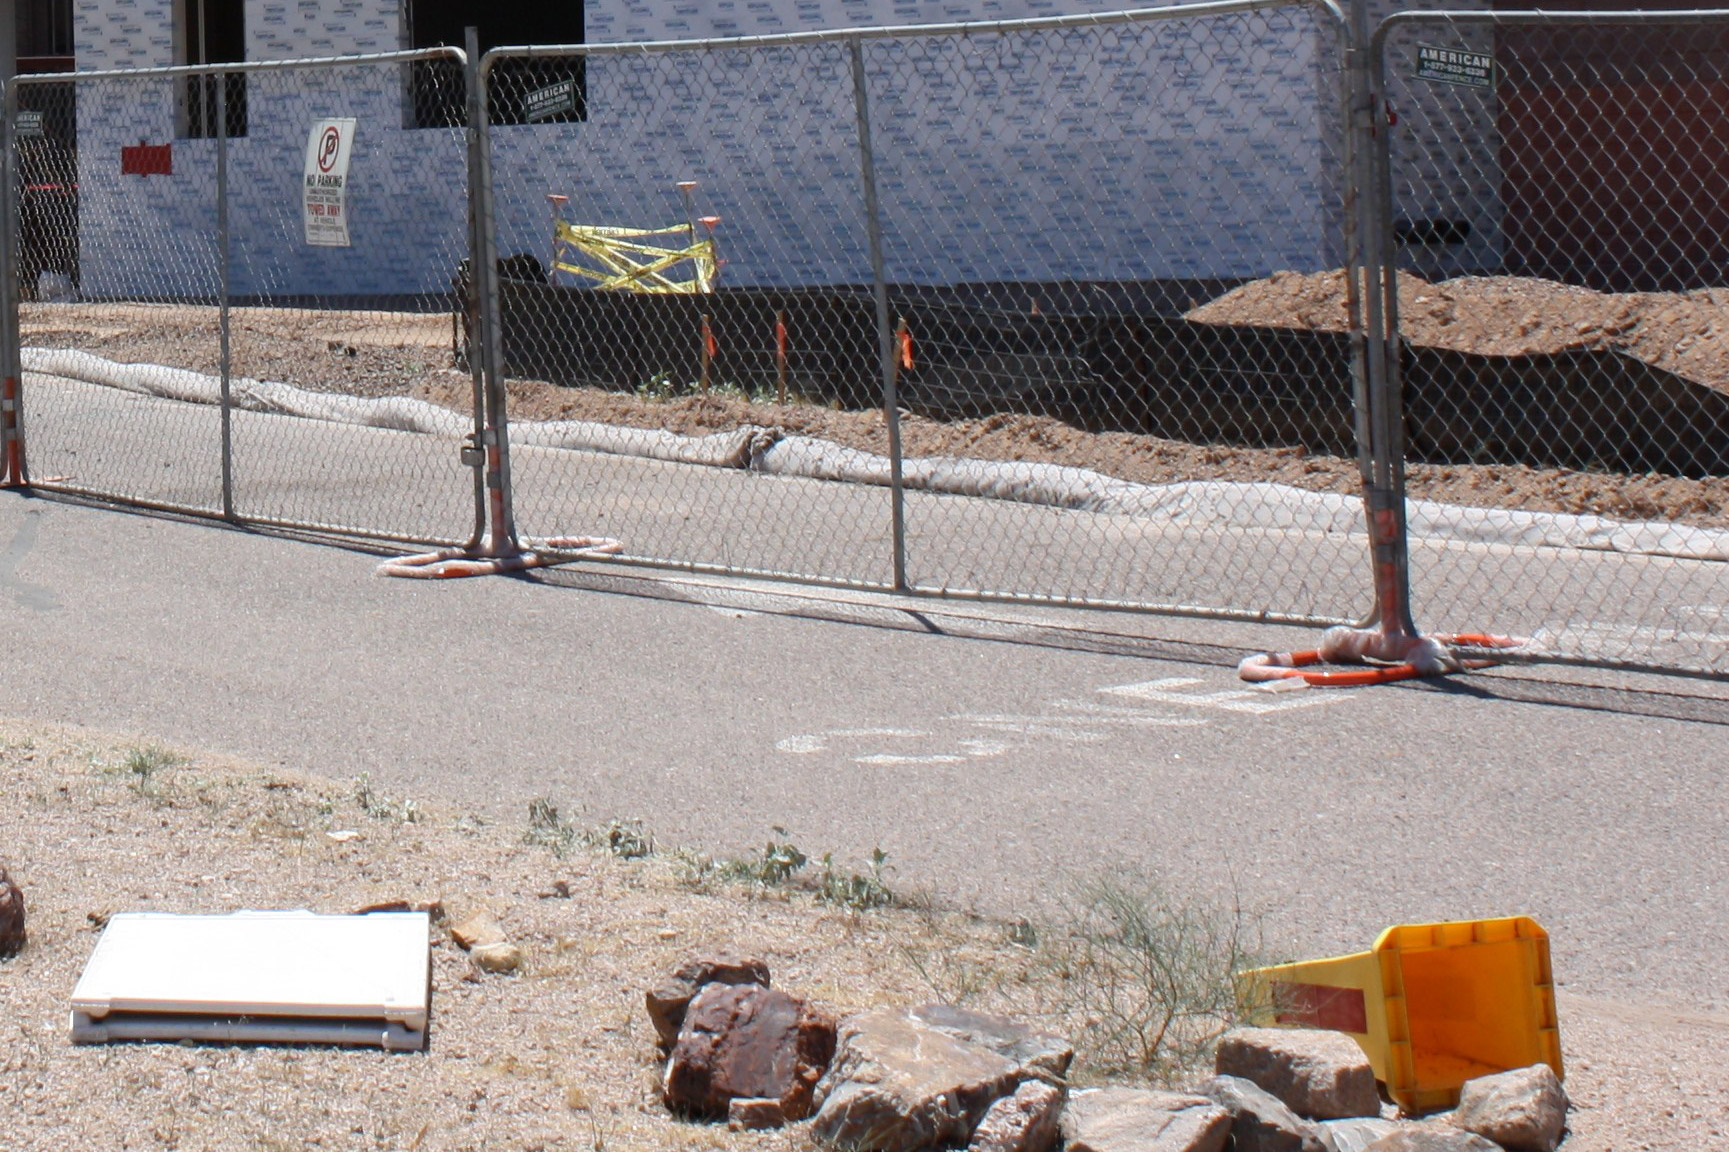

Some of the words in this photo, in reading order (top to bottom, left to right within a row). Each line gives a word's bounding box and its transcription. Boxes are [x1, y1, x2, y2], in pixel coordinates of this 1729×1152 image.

[1420, 47, 1491, 69] AMERICAN
[527, 83, 570, 105] AMERICAN
[306, 174, 314, 187] NO
[317, 173, 342, 188] PARKING
